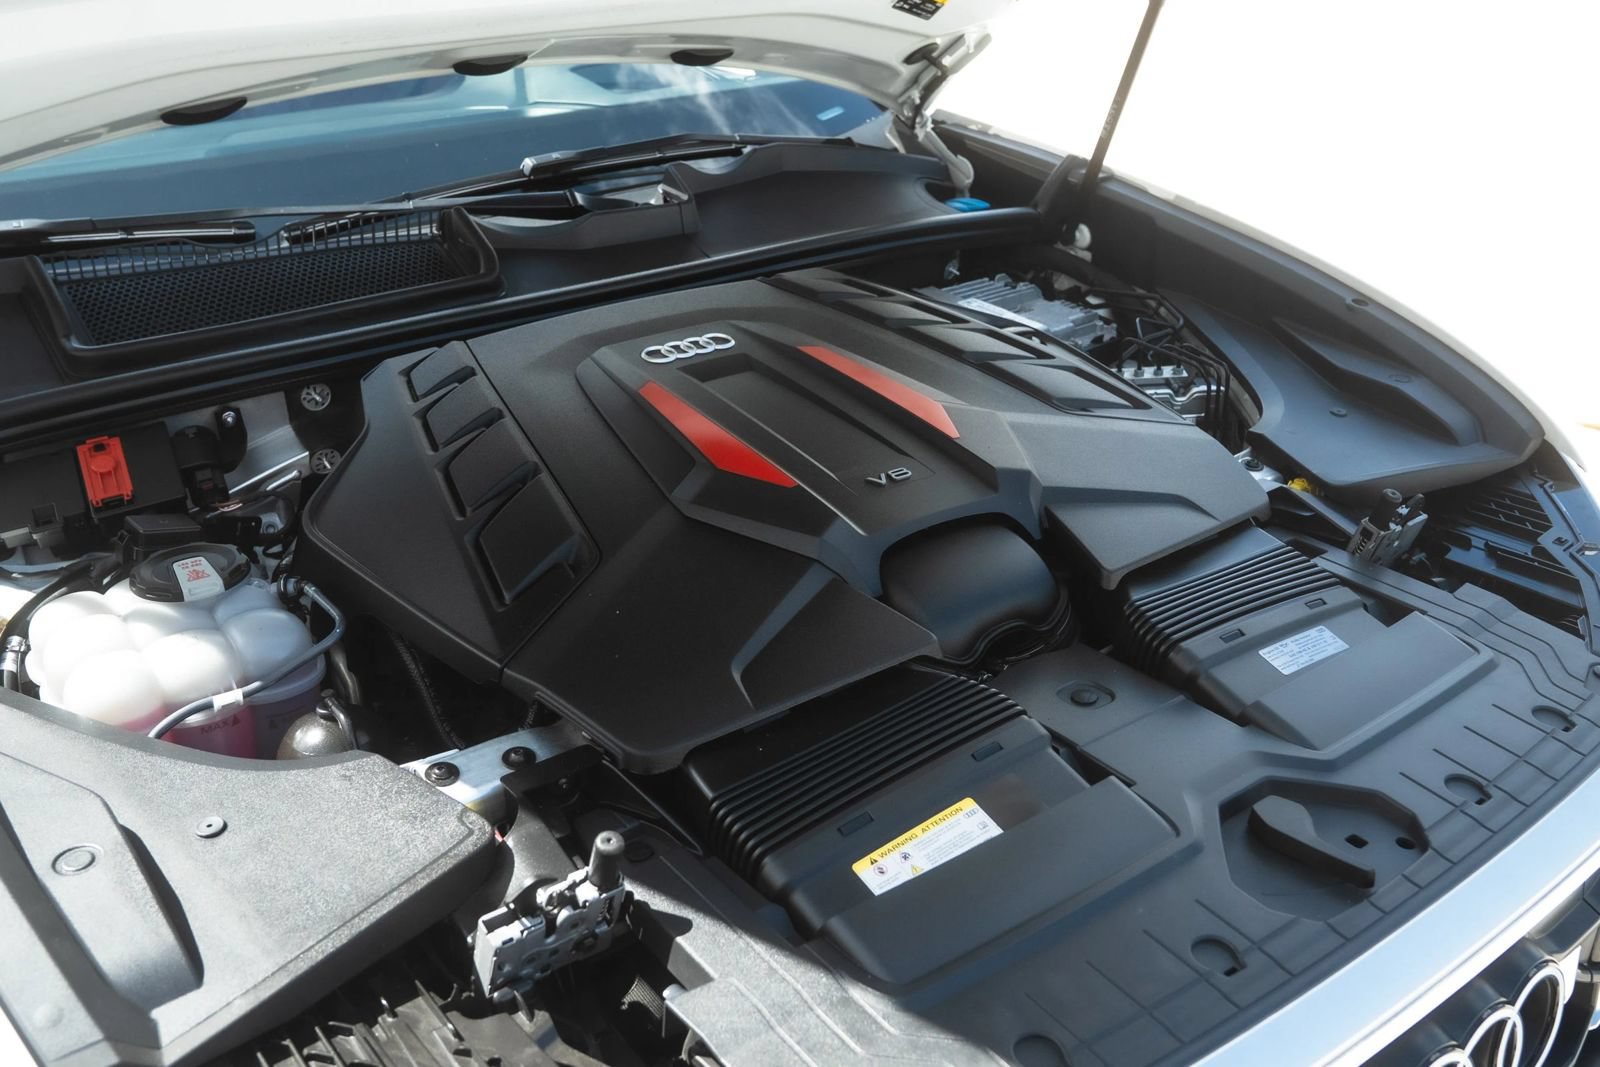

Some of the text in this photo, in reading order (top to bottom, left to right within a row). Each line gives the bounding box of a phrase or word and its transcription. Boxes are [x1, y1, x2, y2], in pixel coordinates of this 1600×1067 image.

[865, 467, 912, 486] V8
[879, 832, 918, 859] WARNING
[921, 806, 964, 834] ATTENTION
